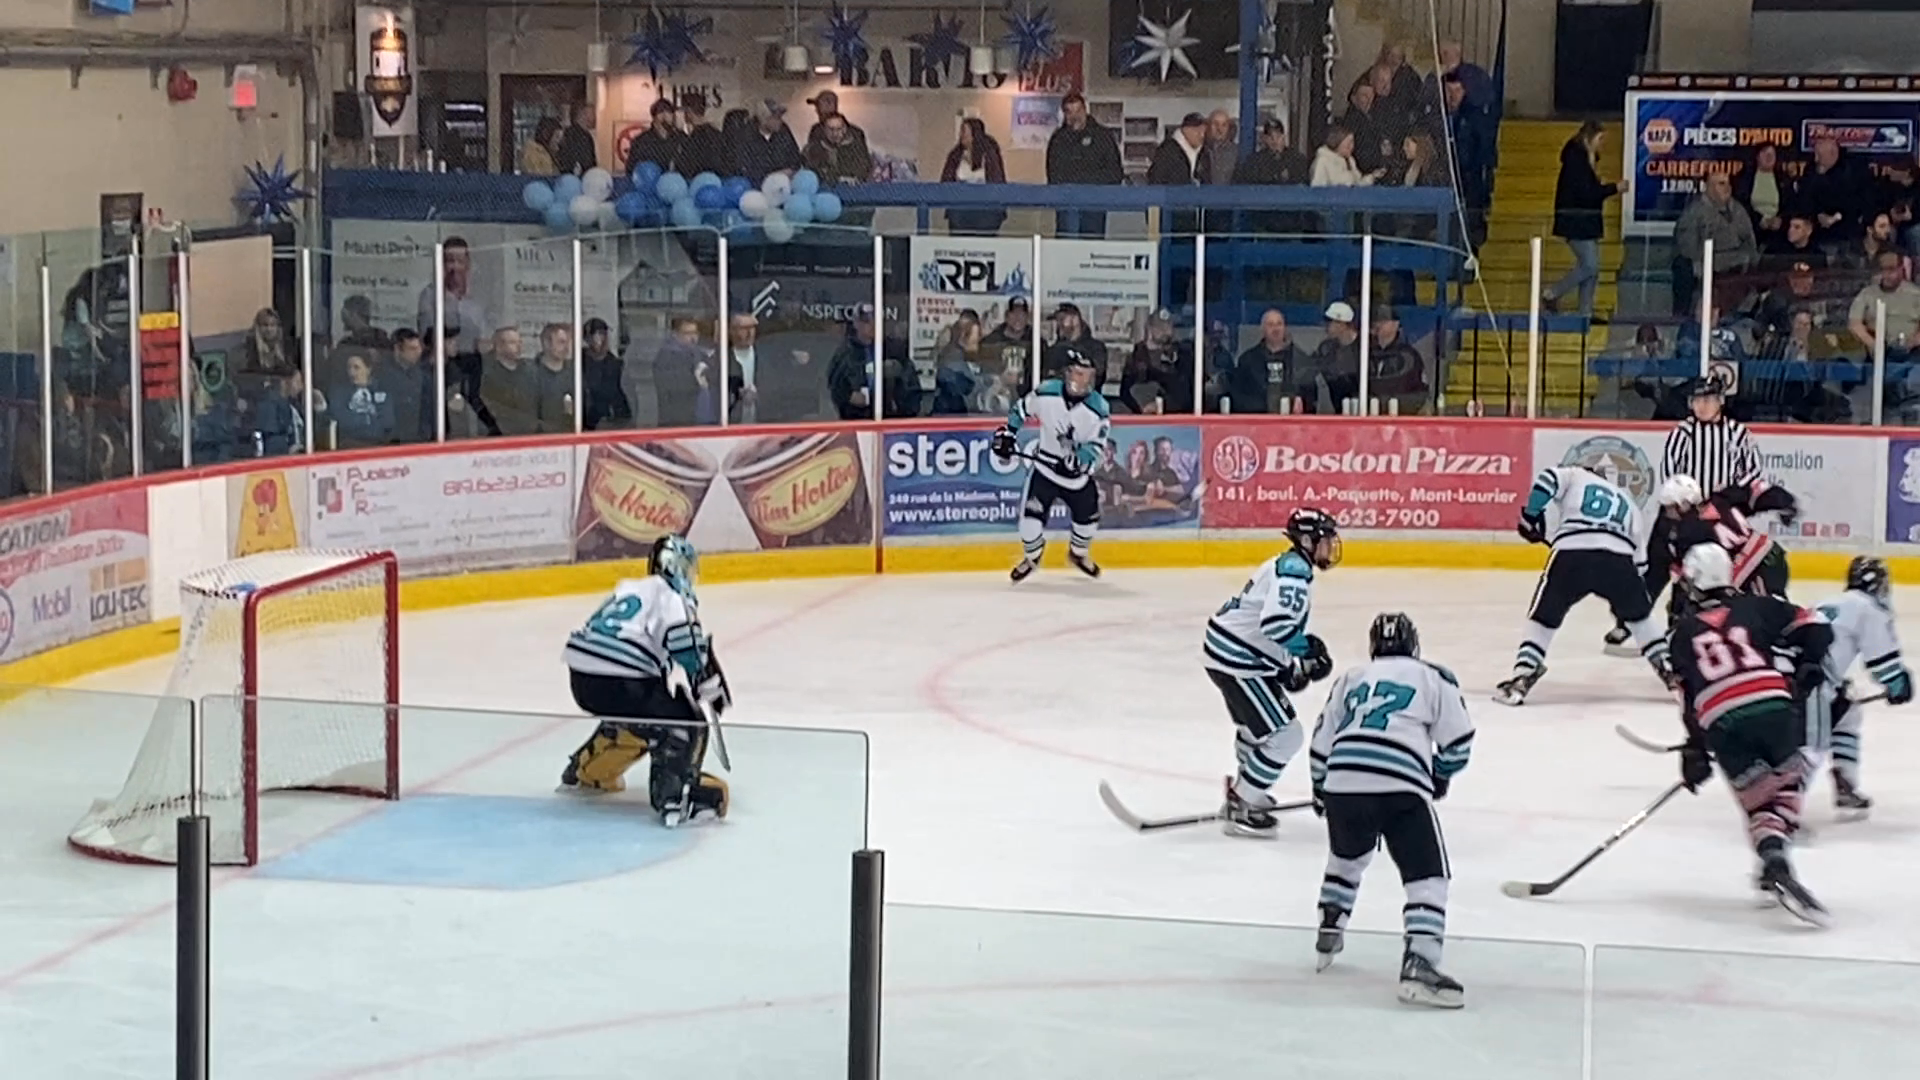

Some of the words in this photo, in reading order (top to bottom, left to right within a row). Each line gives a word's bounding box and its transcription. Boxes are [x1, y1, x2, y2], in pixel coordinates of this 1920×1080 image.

[937, 259, 1000, 293] RPL
[1263, 445, 1402, 474] Boston
[1406, 447, 1512, 475] Pizza
[1216, 486, 1252, 503] 141,
[1257, 485, 1298, 501] boul.
[1410, 487, 1518, 503] Mont-Laurier
[1580, 483, 1629, 524] 61
[1290, 507, 1440, 527] -623-7900
[1278, 585, 1307, 613] 55
